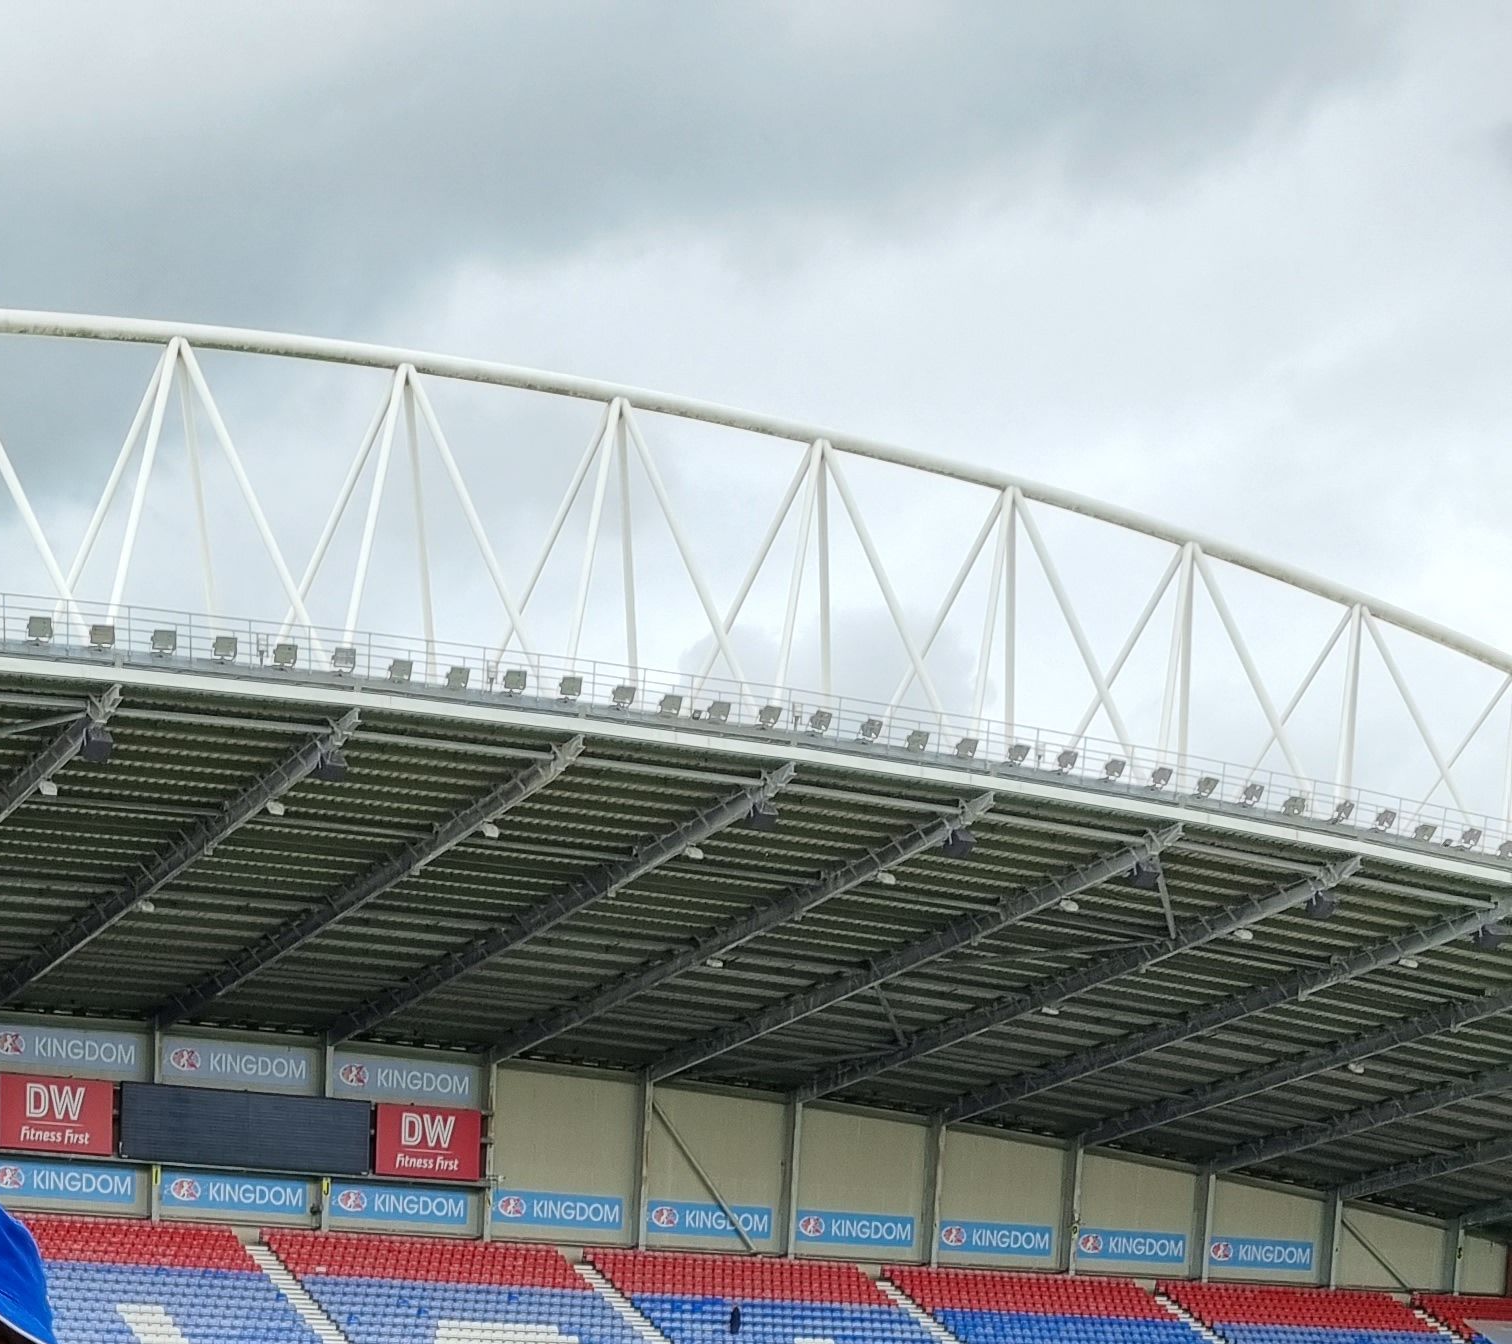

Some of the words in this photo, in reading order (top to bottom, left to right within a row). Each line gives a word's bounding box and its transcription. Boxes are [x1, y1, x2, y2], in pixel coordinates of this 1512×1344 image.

[34, 1035, 136, 1066] KINGDOM
[209, 1052, 307, 1081] KINGDOM
[376, 1068, 470, 1095] KINGDOM
[25, 1082, 86, 1121] DW
[401, 1112, 456, 1149] DW
[33, 1169, 132, 1197] KINGDOM
[209, 1181, 303, 1209] KINGDOM
[373, 1191, 465, 1219] KINGDOM
[532, 1200, 620, 1224] KINGDOM
[685, 1209, 769, 1233] KINGDOM
[831, 1218, 912, 1241] KINGDOM
[972, 1227, 1050, 1250] KINGDOM
[1108, 1236, 1184, 1257] KINGDOM
[1238, 1243, 1311, 1266] KINGDOM
